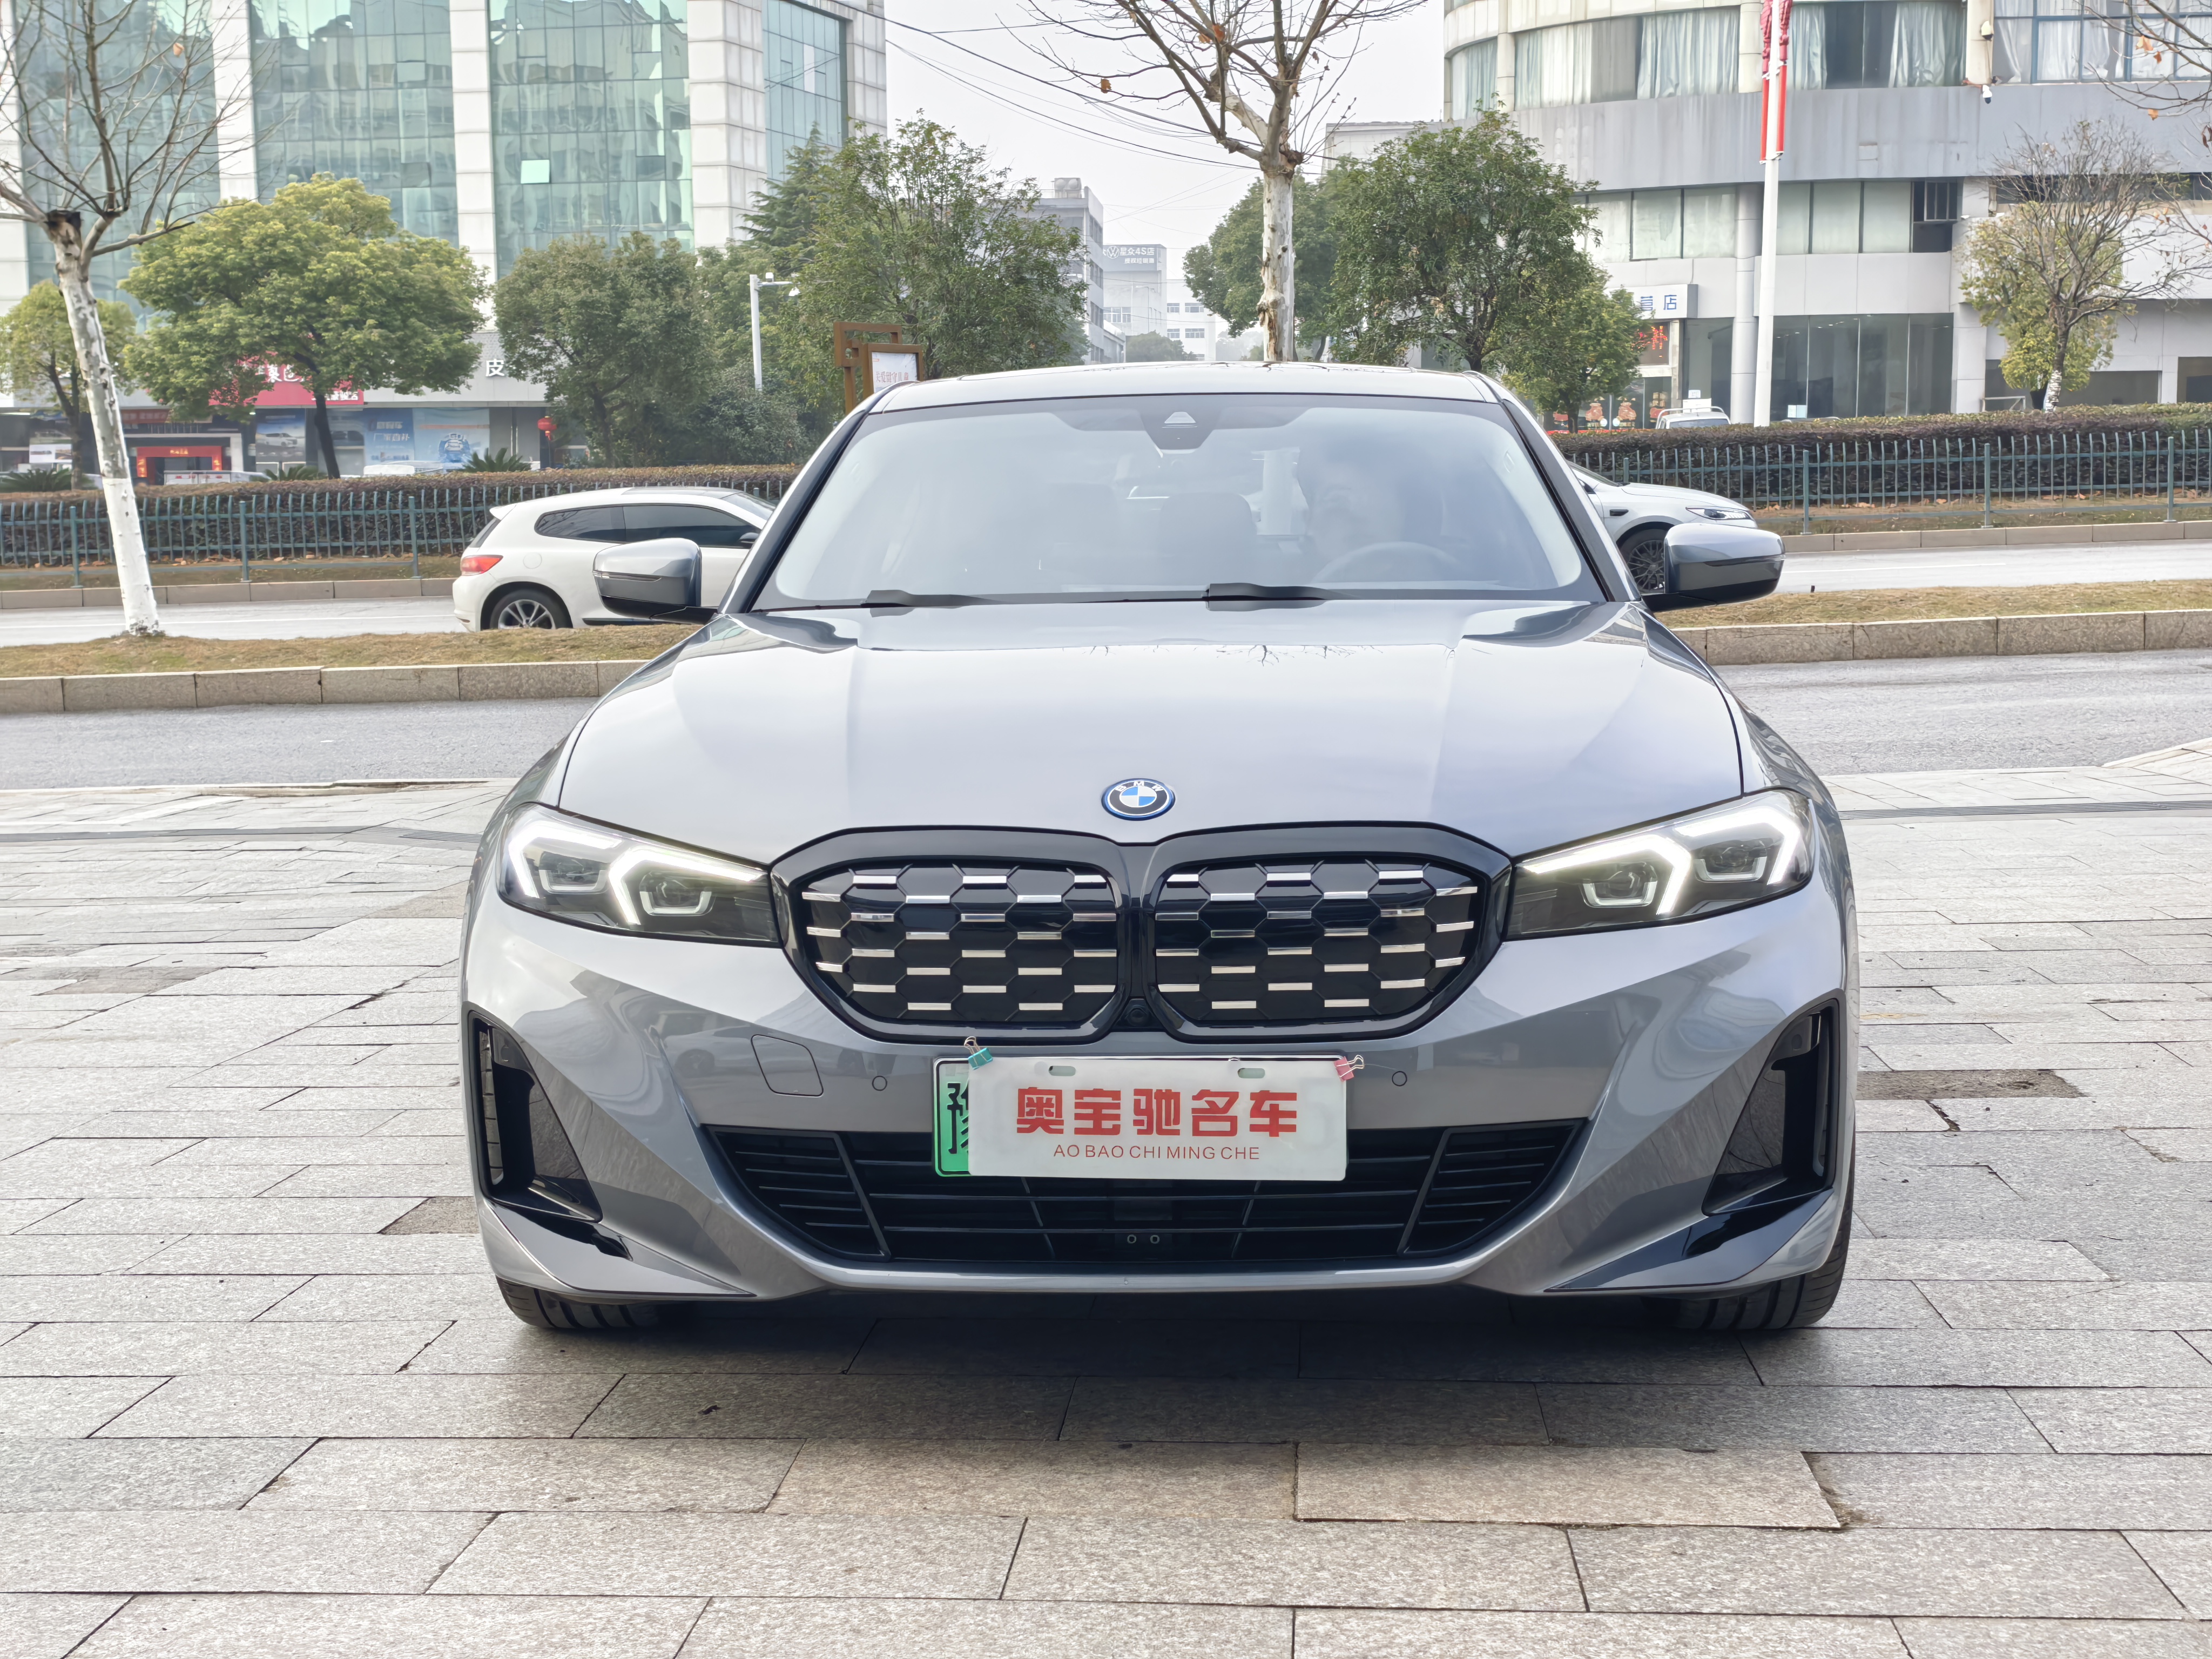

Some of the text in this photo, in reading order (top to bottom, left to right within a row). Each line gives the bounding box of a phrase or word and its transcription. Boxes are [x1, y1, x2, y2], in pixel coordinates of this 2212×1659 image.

[485, 359, 505, 377] 皮
[1115, 781, 1164, 792] BMW
[1016, 1087, 1297, 1137] 奥宝驰名车
[1053, 1144, 1260, 1160] AO BAO CHI MING CHE
